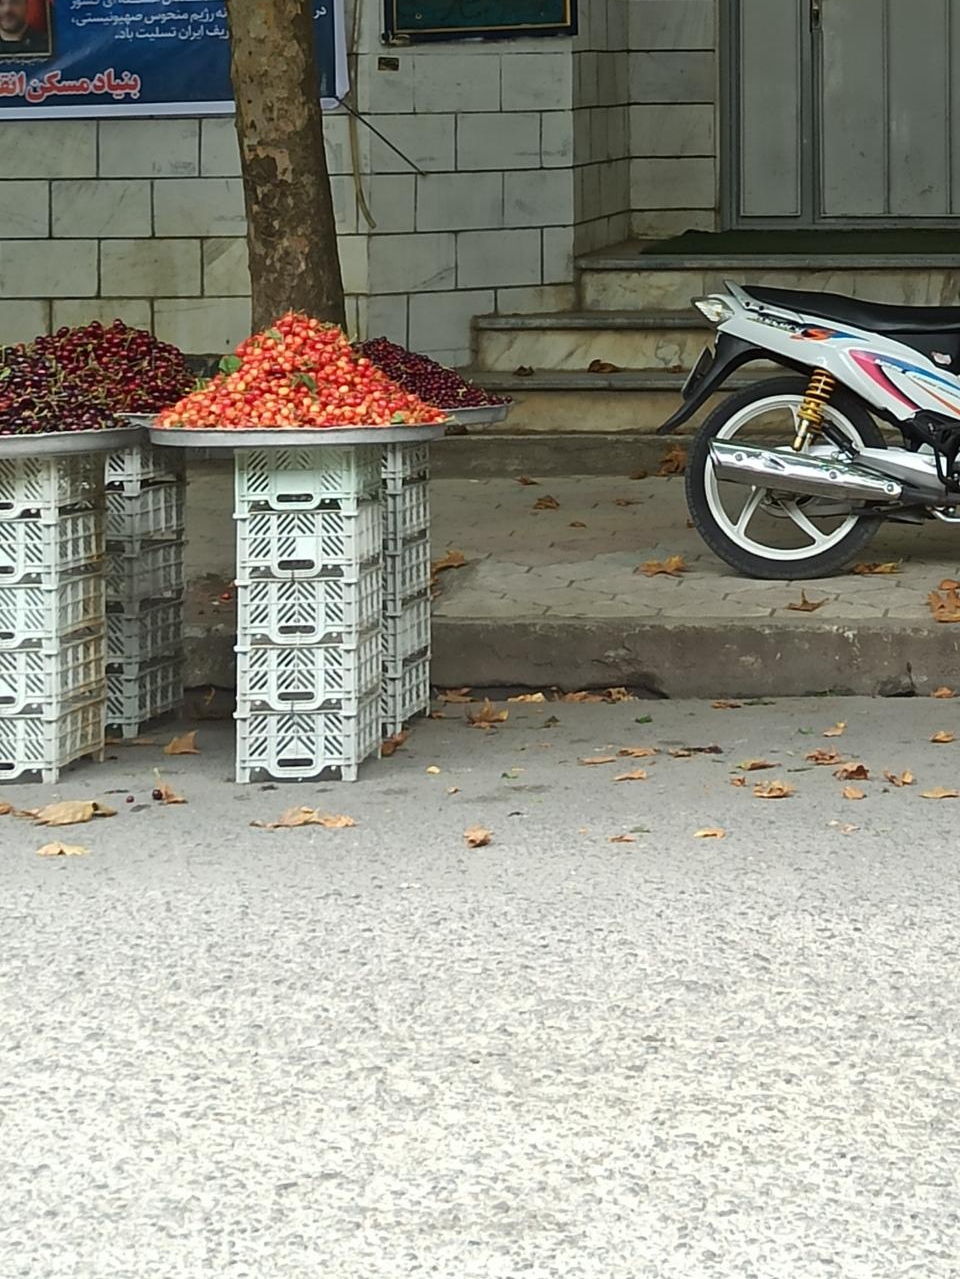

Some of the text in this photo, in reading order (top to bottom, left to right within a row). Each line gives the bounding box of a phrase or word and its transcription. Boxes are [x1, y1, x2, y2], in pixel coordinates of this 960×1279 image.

[144, 11, 188, 25] منحوس
[190, 8, 214, 23] رژیم
[314, 6, 327, 19] در
[135, 26, 176, 41] تسلیت
[178, 25, 204, 41] ایران
[205, 26, 229, 40] ریف
[25, 70, 91, 104] مسکن
[92, 68, 140, 99] بنیاد
